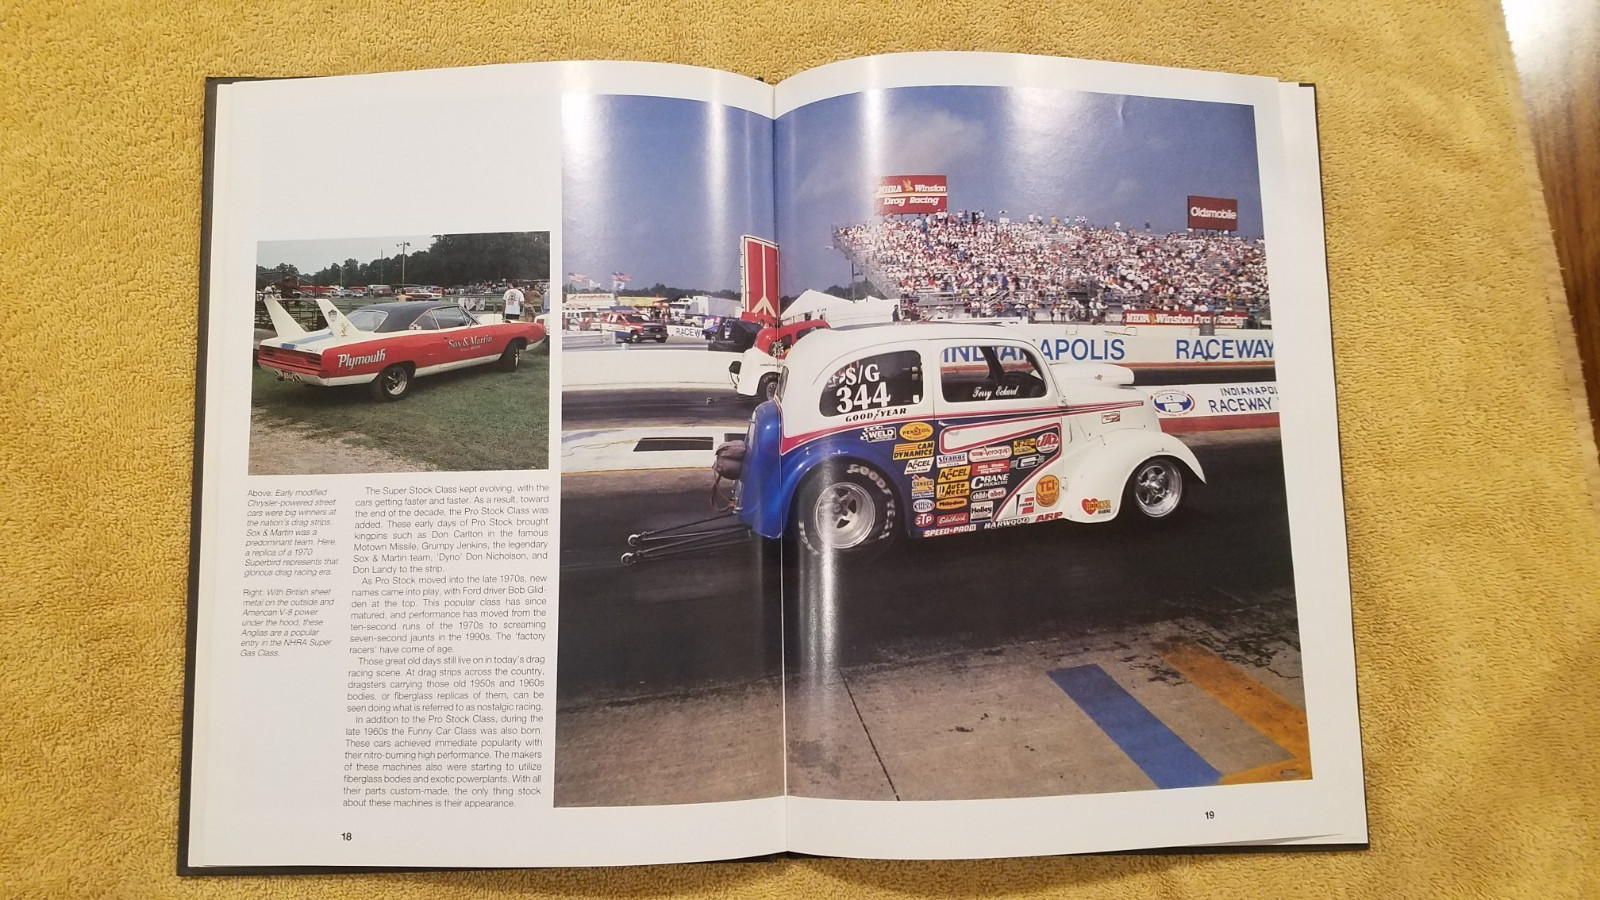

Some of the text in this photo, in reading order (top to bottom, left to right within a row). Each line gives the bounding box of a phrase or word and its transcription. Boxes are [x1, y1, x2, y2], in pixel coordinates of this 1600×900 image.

[884, 196, 939, 206] Drag Racing
[1190, 206, 1237, 220] Oldsmobile
[1155, 313, 1194, 324] Winston
[338, 348, 386, 370] Plymouth
[846, 364, 880, 386] S/G
[836, 382, 892, 413] 344
[972, 386, 992, 400] Terry
[1208, 397, 1272, 412] RACEWAY
[868, 430, 894, 438] WELD
[894, 450, 932, 458] DYNAMICS
[971, 474, 1010, 488] CRANE
[1040, 480, 1056, 492] TCI
[275, 489, 292, 498] Early
[365, 484, 549, 496] The Super Stock Class kept evolving, with the
[247, 499, 313, 508] Chrysler-powered
[374, 498, 402, 508] getting
[404, 497, 426, 505] faster
[429, 497, 444, 505] and
[446, 497, 470, 505] faster.
[474, 496, 483, 504] As
[493, 496, 517, 505] result,
[520, 496, 549, 504] toward
[284, 509, 296, 518] big
[355, 509, 367, 517] the
[370, 509, 385, 517] end
[398, 509, 411, 517] the
[413, 508, 446, 517] decade,
[464, 508, 478, 516] Pro
[481, 507, 504, 515] Stock
[506, 507, 529, 515] Class
[972, 506, 992, 514] Holley
[916, 514, 932, 525] STP
[1036, 512, 1062, 522] ARP
[290, 519, 308, 528] drag
[354, 520, 382, 528] added.
[387, 520, 411, 528] These
[414, 519, 433, 530] early
[437, 519, 456, 529] days
[489, 518, 512, 526] Stock
[516, 518, 549, 528] brought
[245, 539, 292, 548] predominant
[251, 548, 276, 558] replica
[244, 559, 281, 568] Superbird
[282, 559, 321, 568] represents
[244, 569, 272, 578] glorious
[274, 569, 292, 578] drag
[294, 568, 317, 578] racing
[351, 609, 546, 620] matured, and performance has moved from the
[434, 738, 477, 746] immediate
[480, 738, 521, 748] popularity
[343, 775, 382, 785] fiberglass
[456, 775, 509, 785] powerplants.
[464, 800, 515, 809] appearance.
[1205, 810, 1215, 819] 19
[342, 832, 352, 841] 18
